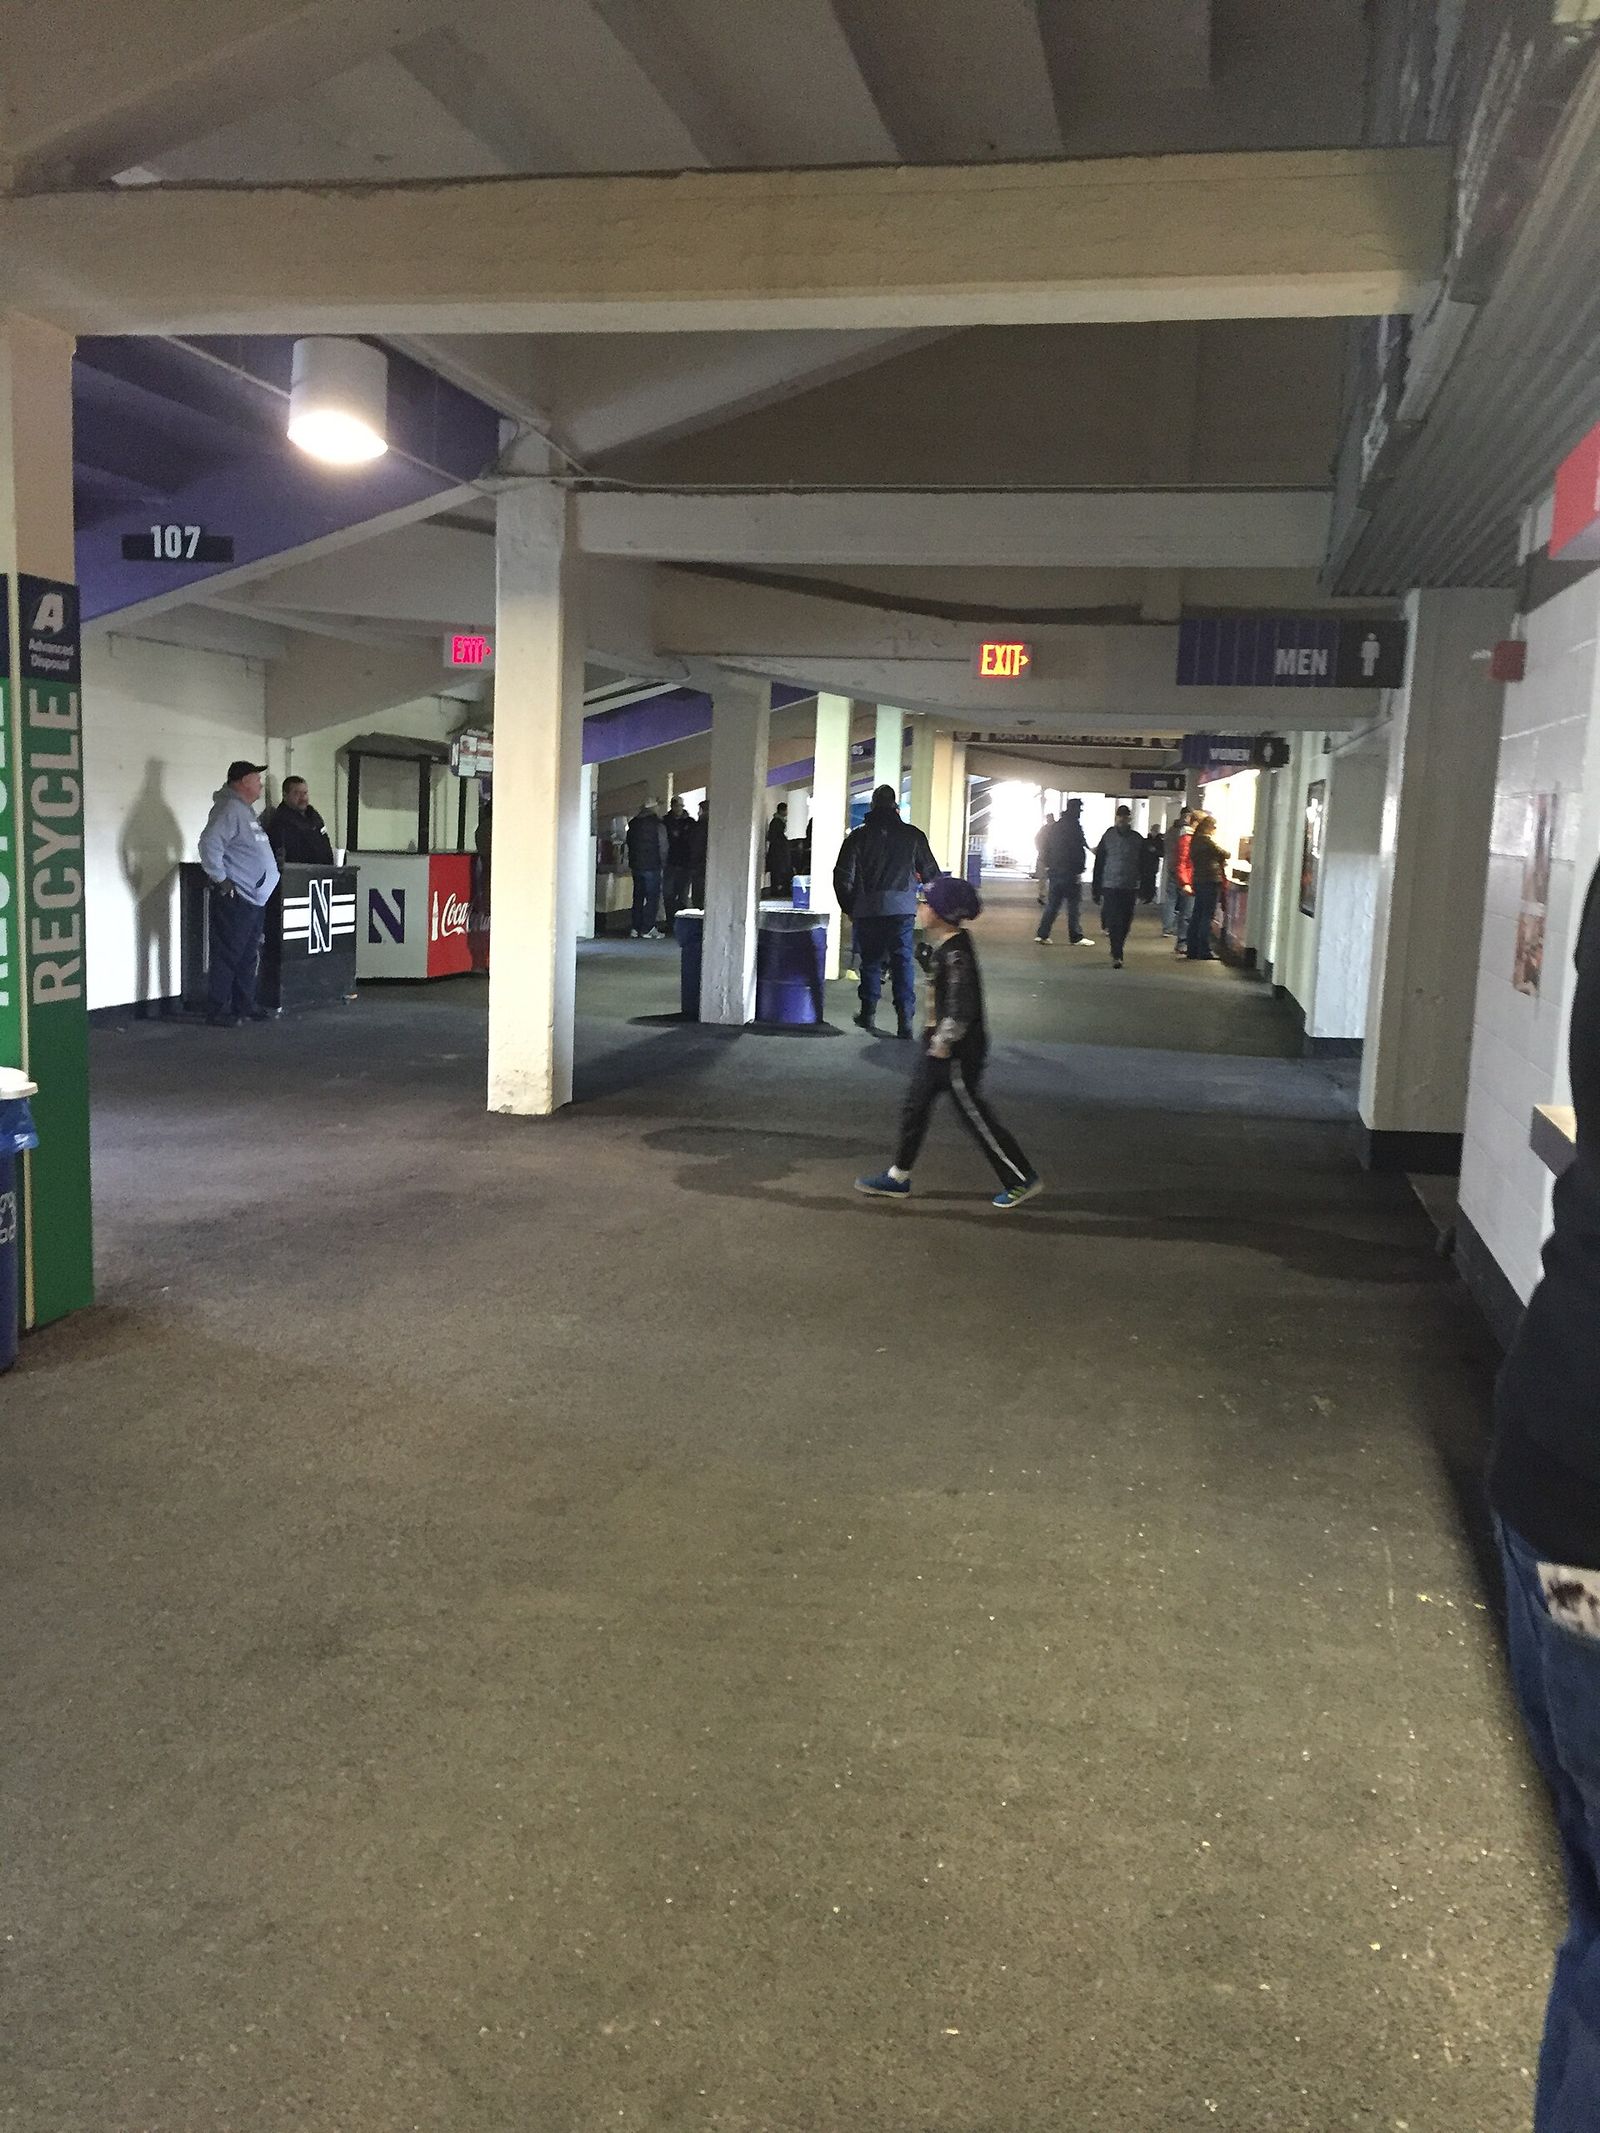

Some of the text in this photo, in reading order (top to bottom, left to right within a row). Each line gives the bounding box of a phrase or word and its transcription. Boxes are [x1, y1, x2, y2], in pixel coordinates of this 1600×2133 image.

[150, 525, 201, 559] 107
[452, 636, 485, 665] EXIT
[981, 644, 1023, 676] EXIT
[1274, 648, 1328, 676] MEN
[29, 688, 82, 1004] RECYCLE
[368, 888, 405, 943] N
